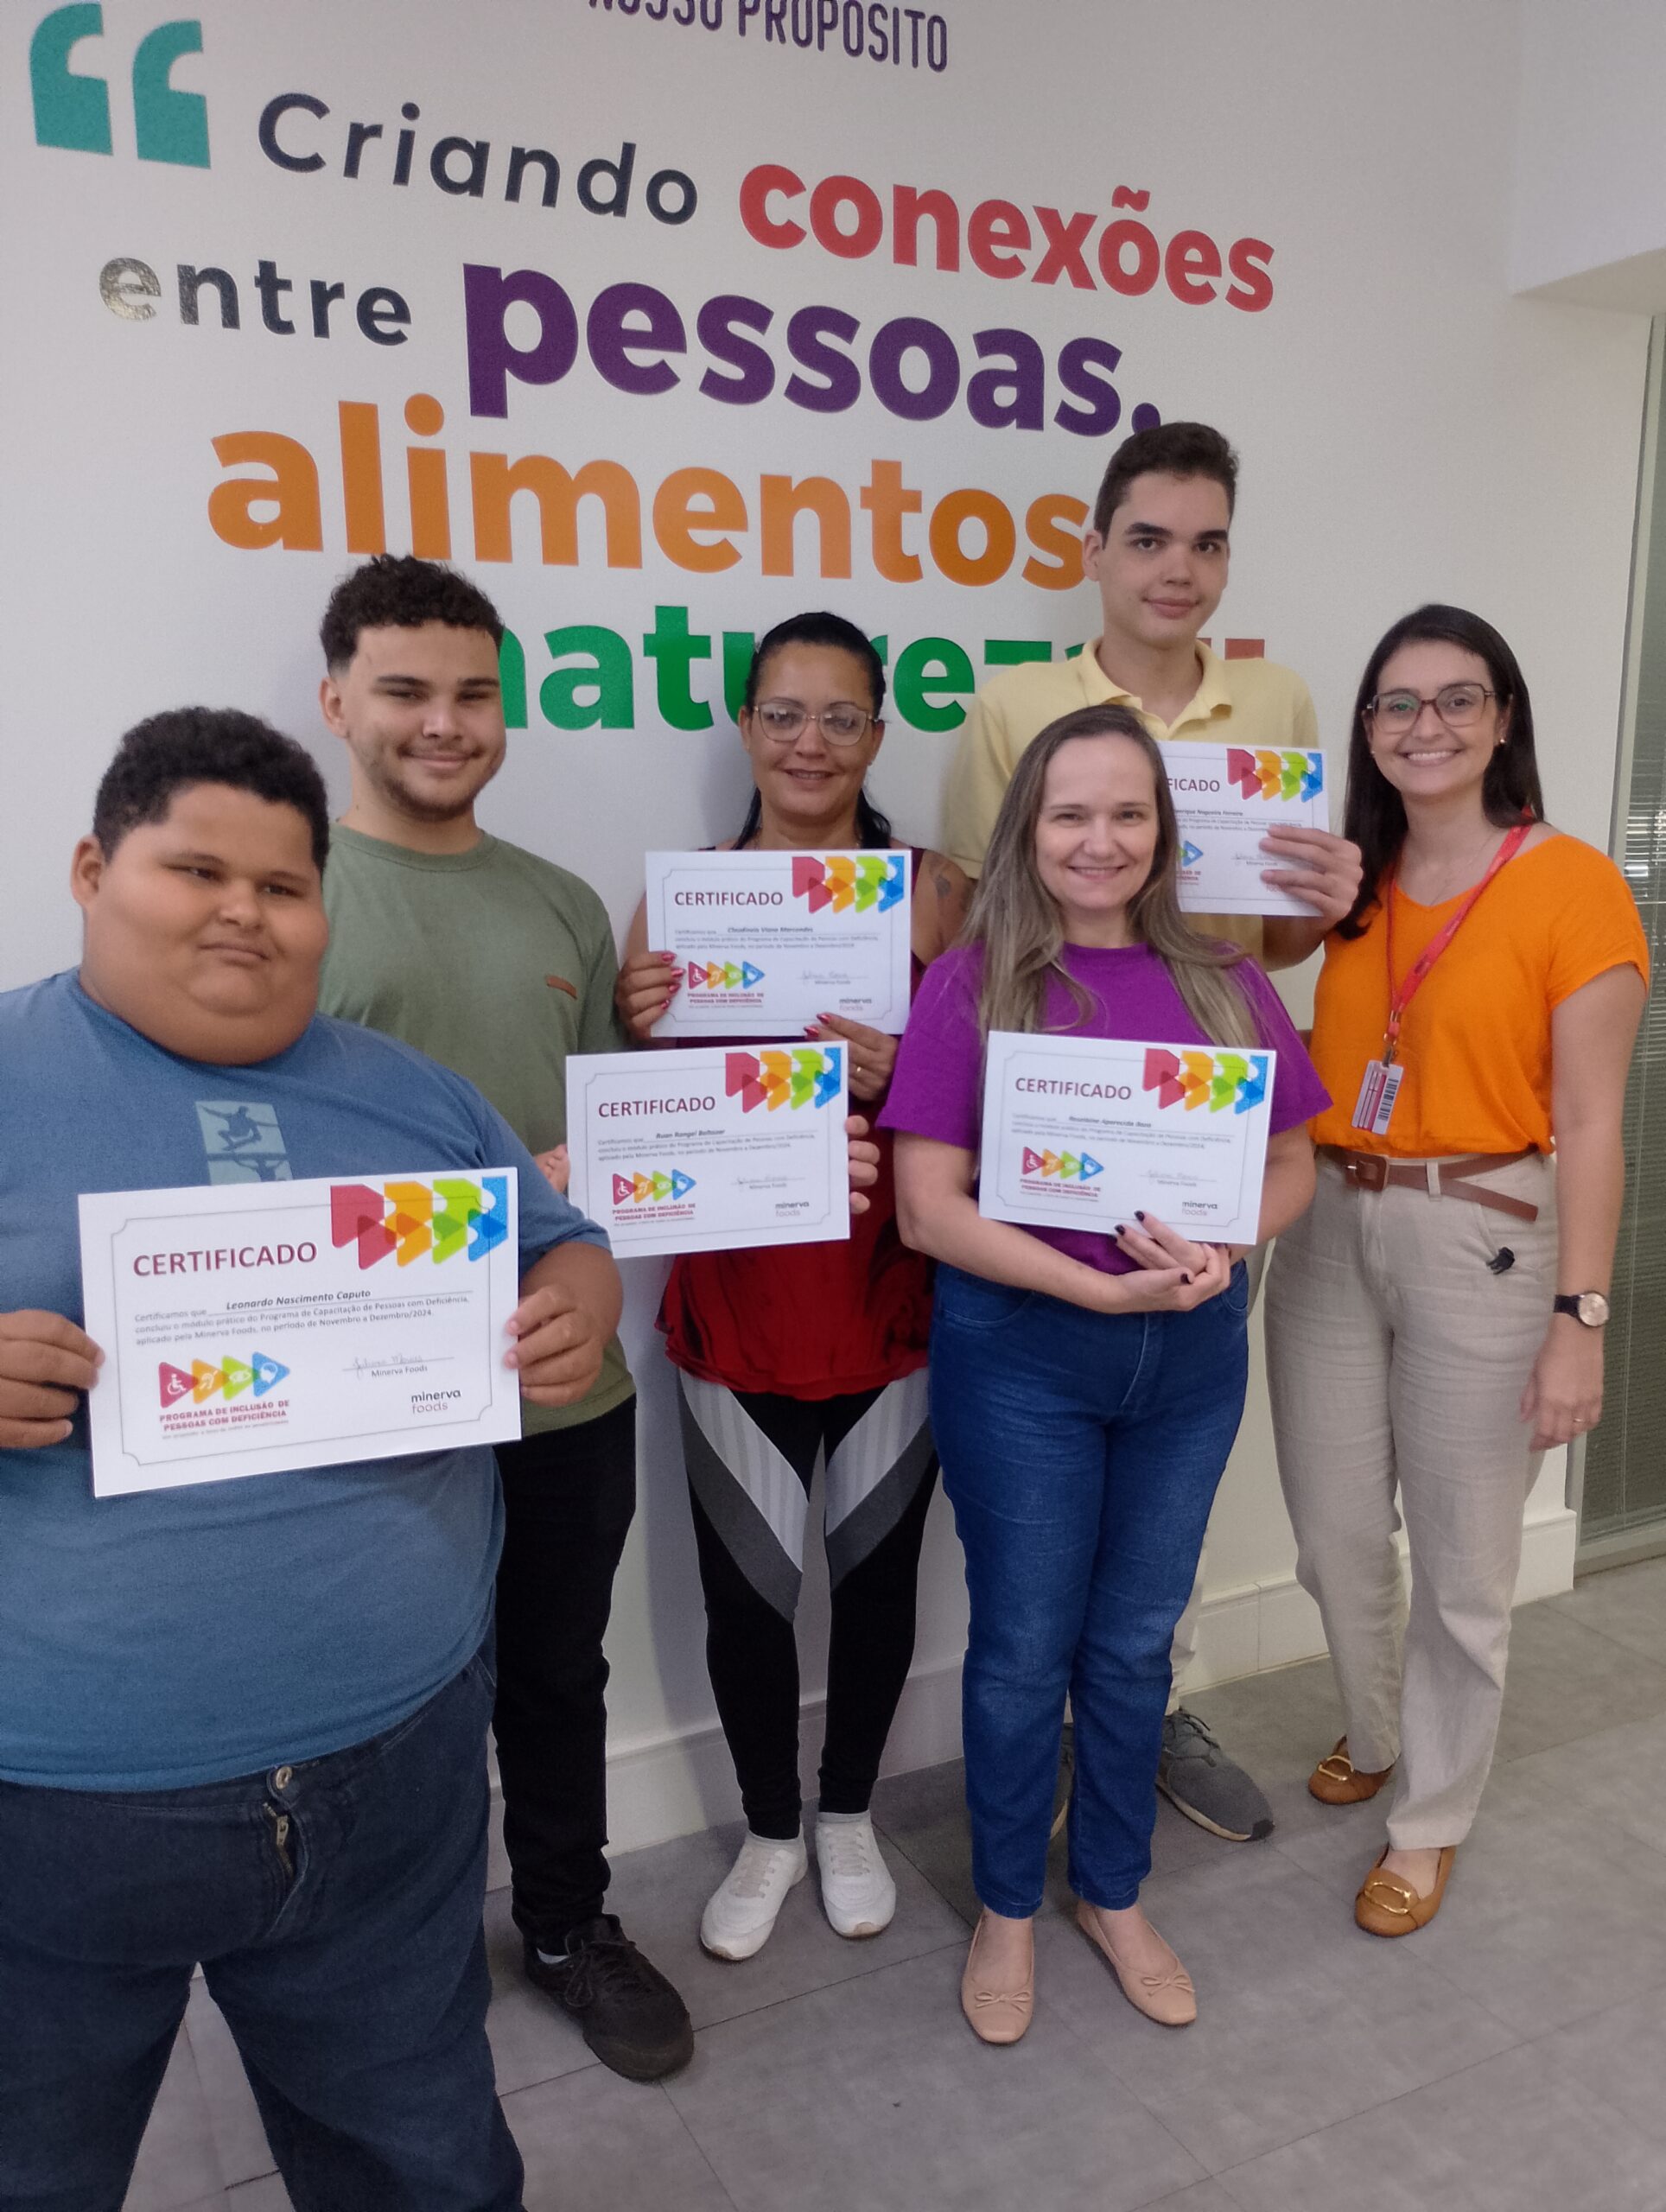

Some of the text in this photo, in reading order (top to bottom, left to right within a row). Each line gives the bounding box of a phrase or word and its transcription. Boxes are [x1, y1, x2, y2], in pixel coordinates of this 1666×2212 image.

[258, 92, 698, 226] Criando
[739, 163, 1275, 313] conexões
[99, 257, 412, 346] entre
[207, 394, 1091, 591] alimentos
[674, 892, 784, 906] CERTIFICADO
[1015, 1077, 1132, 1100] CERTIFICADO
[598, 1096, 715, 1117] CERTIFICADO
[1181, 1200, 1218, 1210] minerva
[133, 1242, 318, 1276] CERTIFICADO
[135, 1290, 371, 1323] Certificamos que Leonardo Nascimento Caputo
[247, 1314, 258, 1323] do
[260, 1310, 299, 1322] Programa
[301, 1309, 312, 1318] de
[313, 1305, 362, 1317] Capacitação
[363, 1303, 373, 1312] de
[375, 1301, 405, 1310] Pessoas
[194, 1329, 230, 1339] Minerva
[261, 1325, 272, 1333] no
[307, 1319, 317, 1329] de
[319, 1315, 361, 1327] Novembro
[371, 1364, 428, 1378] Minerva Foods
[410, 1389, 461, 1403] minerva
[160, 1408, 213, 1422] PROGRAMA
[229, 1400, 274, 1413] INCLUSÃO
[277, 1399, 290, 1408] DE
[412, 1401, 448, 1414] foods
[163, 1419, 207, 1432] PESSOAS
[208, 1415, 229, 1427] COM
[231, 1410, 287, 1423] DEFICIÊNCIA
